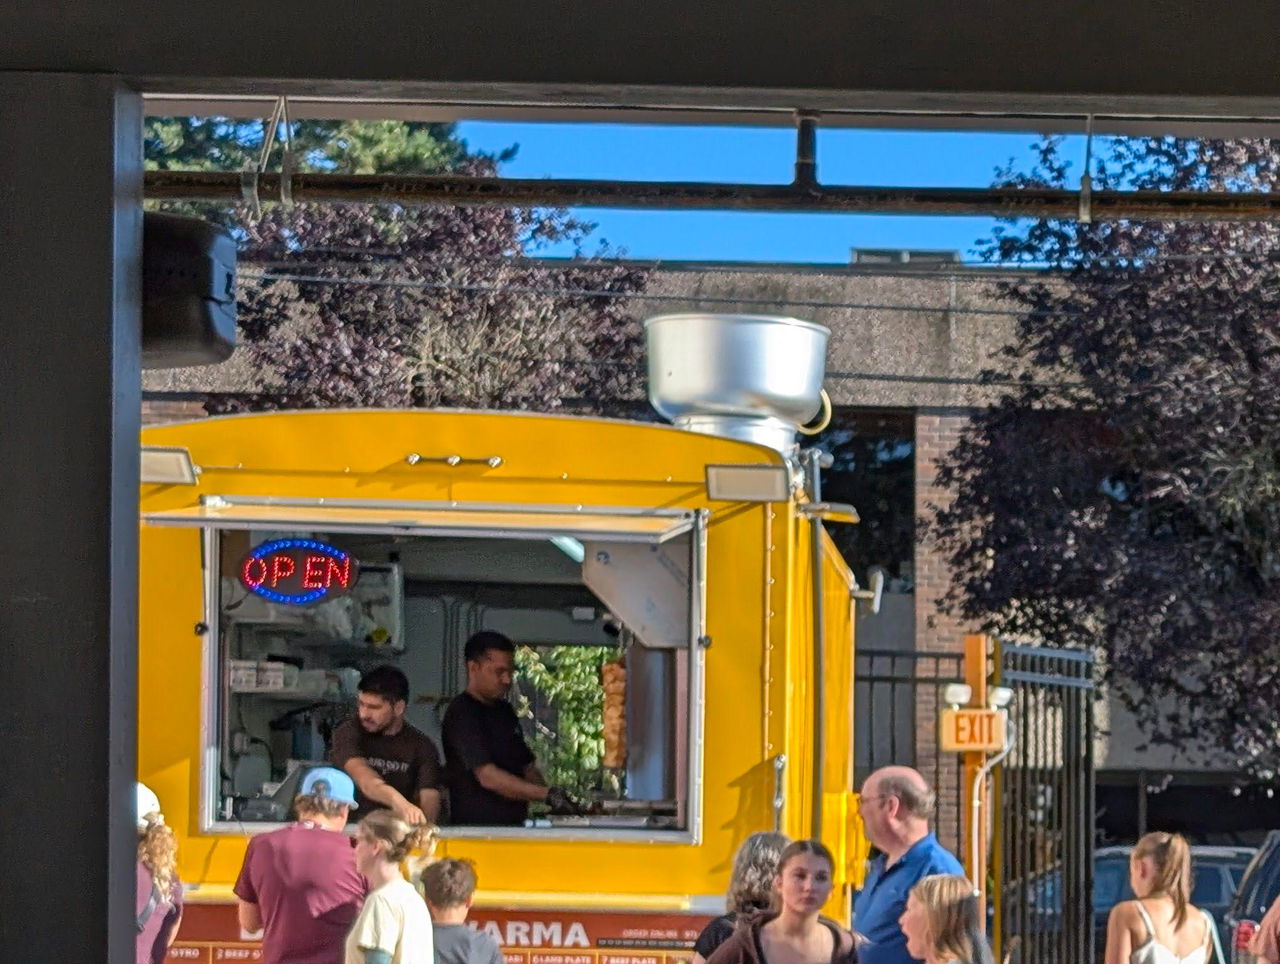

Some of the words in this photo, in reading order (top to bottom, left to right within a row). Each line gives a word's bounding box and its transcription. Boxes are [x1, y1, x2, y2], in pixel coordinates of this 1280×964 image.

[243, 555, 350, 589] OPEN
[954, 713, 996, 745] EXIT
[468, 920, 591, 948] ARMA
